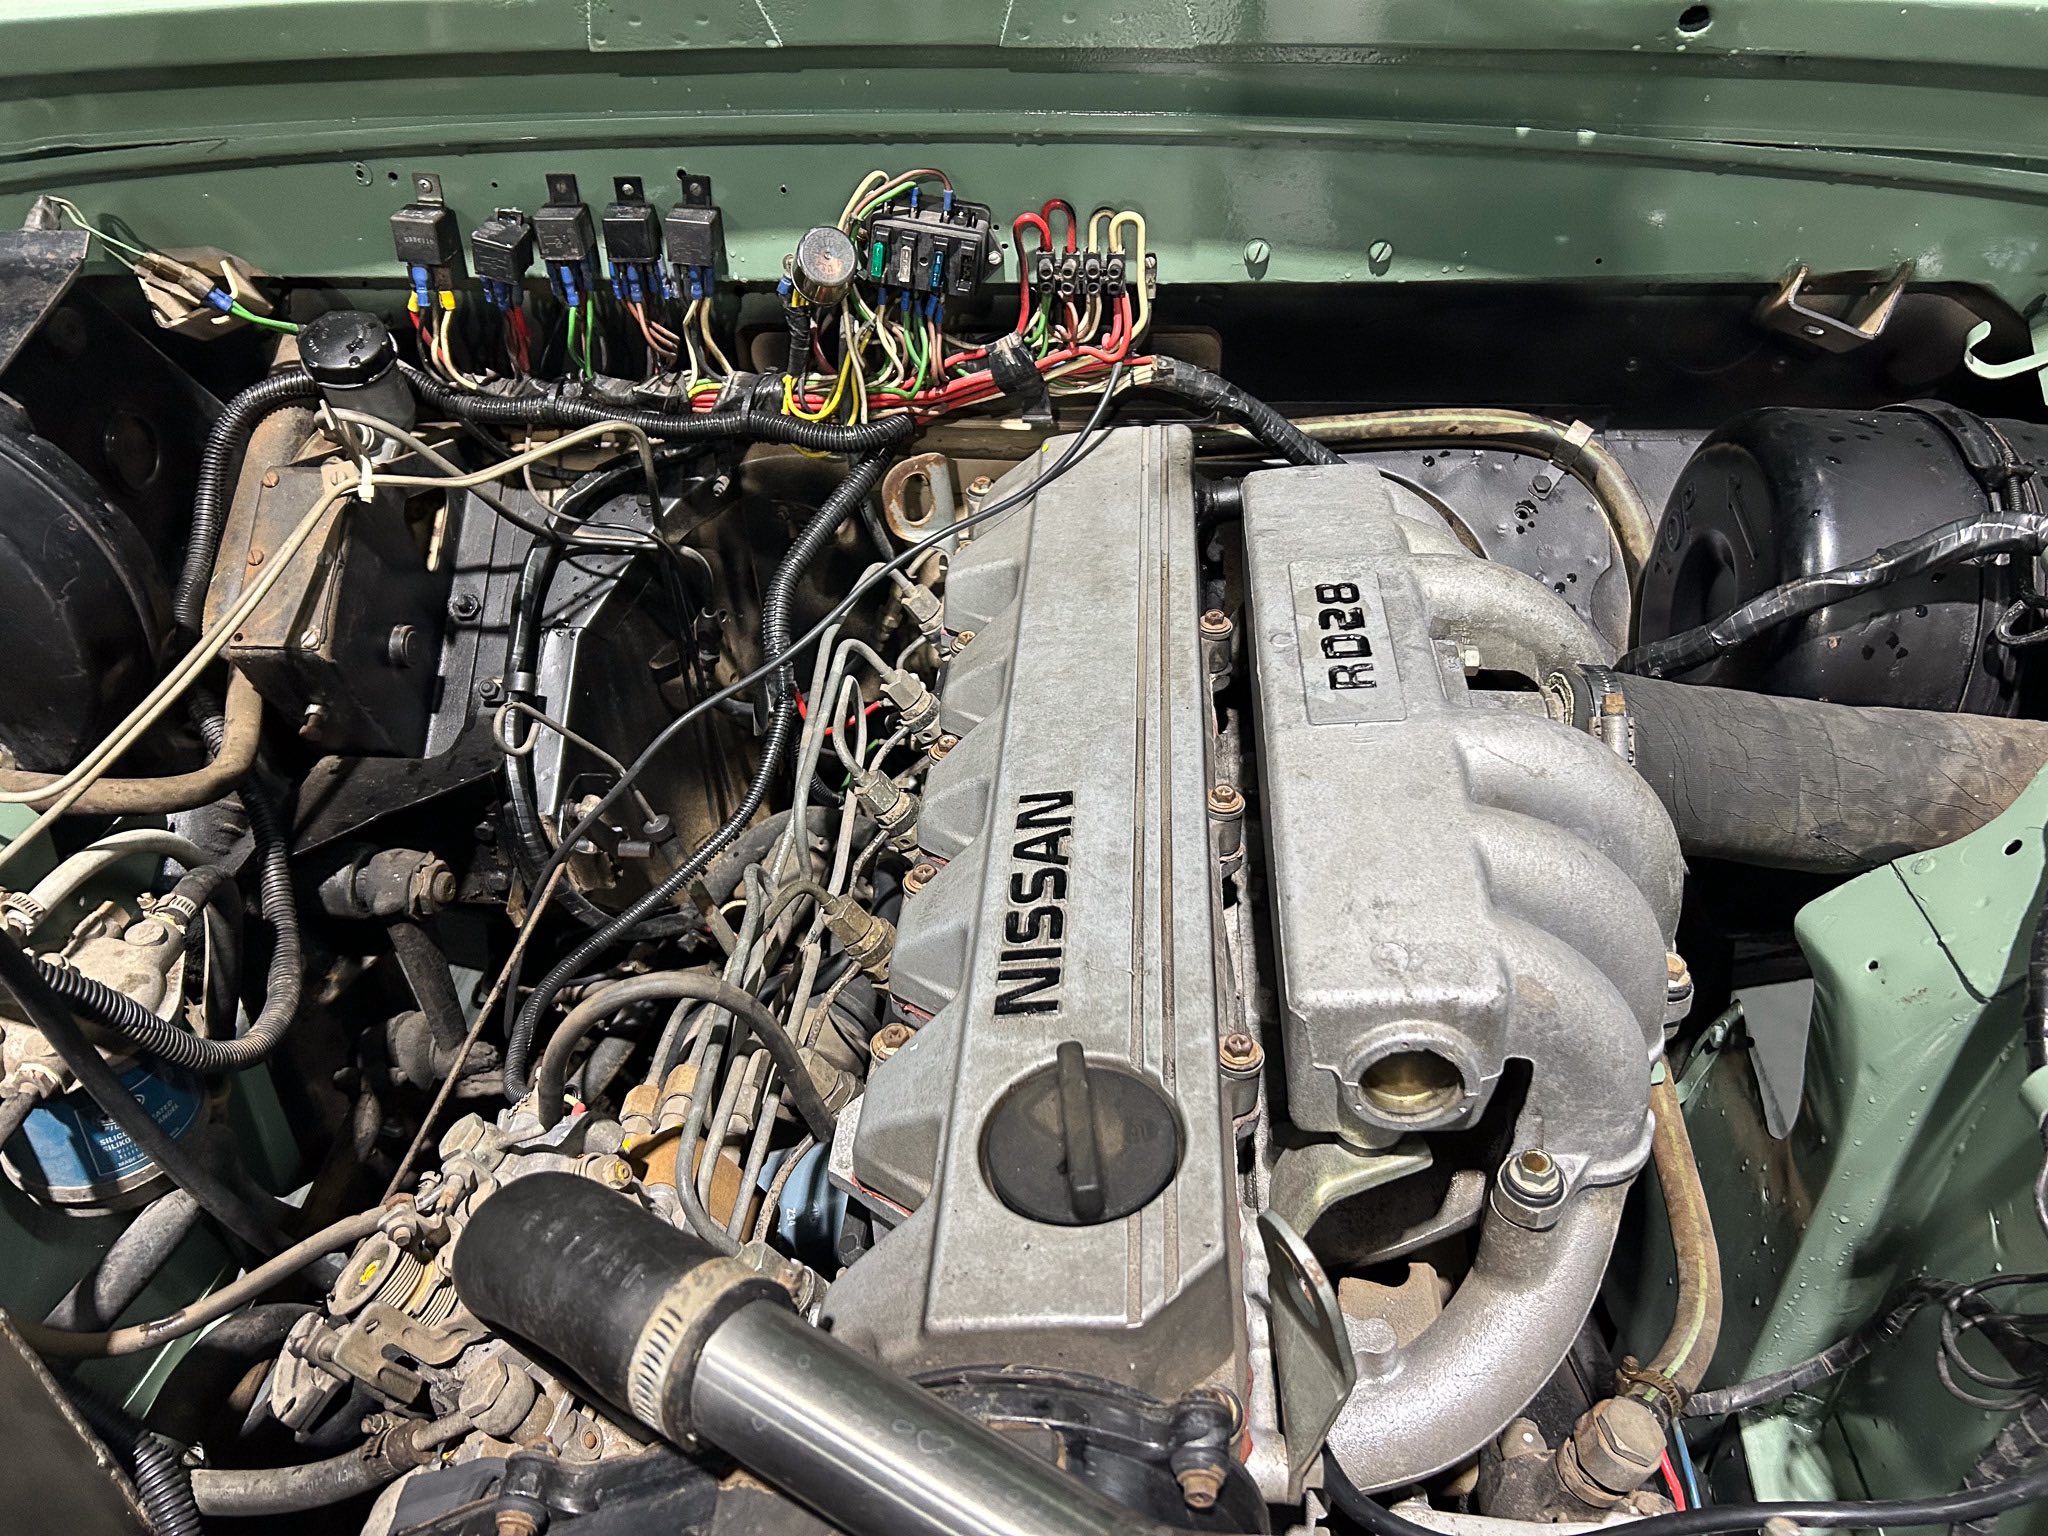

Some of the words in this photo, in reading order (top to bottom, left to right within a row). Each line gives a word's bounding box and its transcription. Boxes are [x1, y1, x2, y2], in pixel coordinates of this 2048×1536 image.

[1653, 480, 1697, 576] TOP
[1315, 582, 1377, 690] RD28
[994, 790, 1074, 1016] NISSAN
